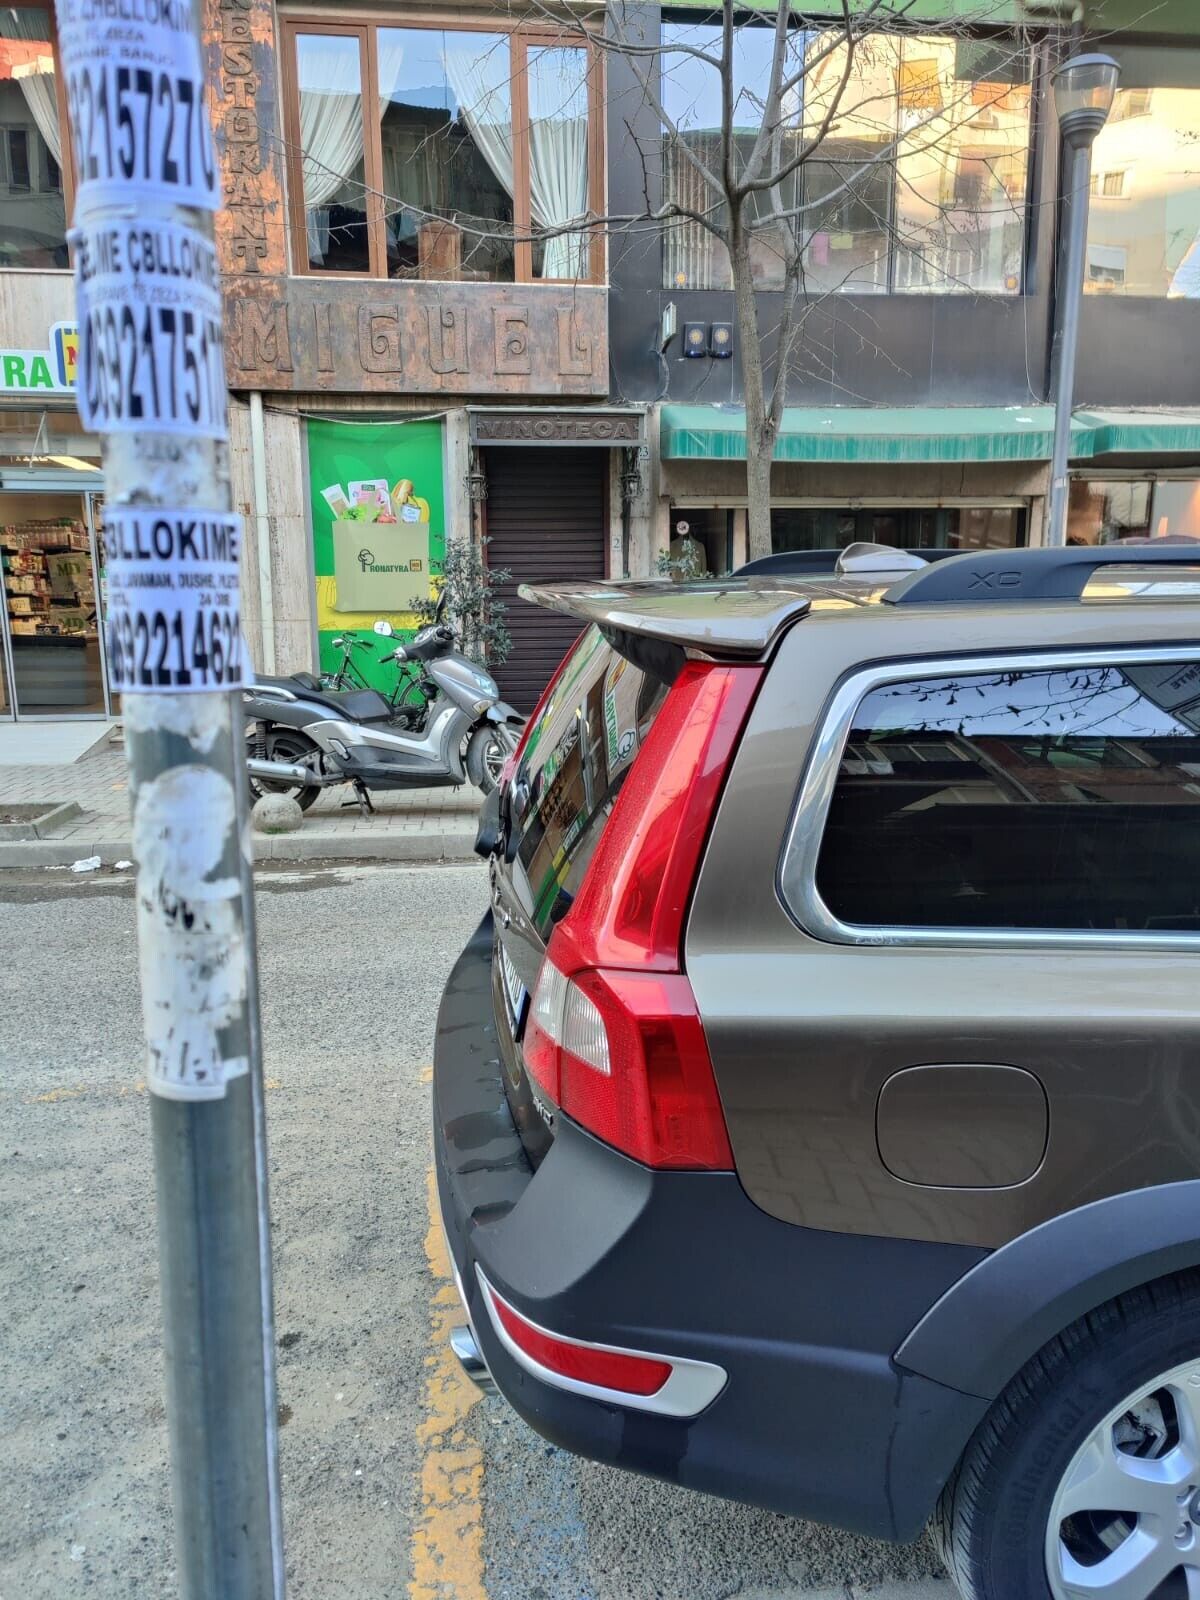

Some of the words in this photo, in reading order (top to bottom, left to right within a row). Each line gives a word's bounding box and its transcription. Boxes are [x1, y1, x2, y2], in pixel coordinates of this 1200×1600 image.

[239, 300, 594, 376] MIGUEL
[478, 420, 634, 440] VINOTECA
[967, 571, 1022, 590] XC
